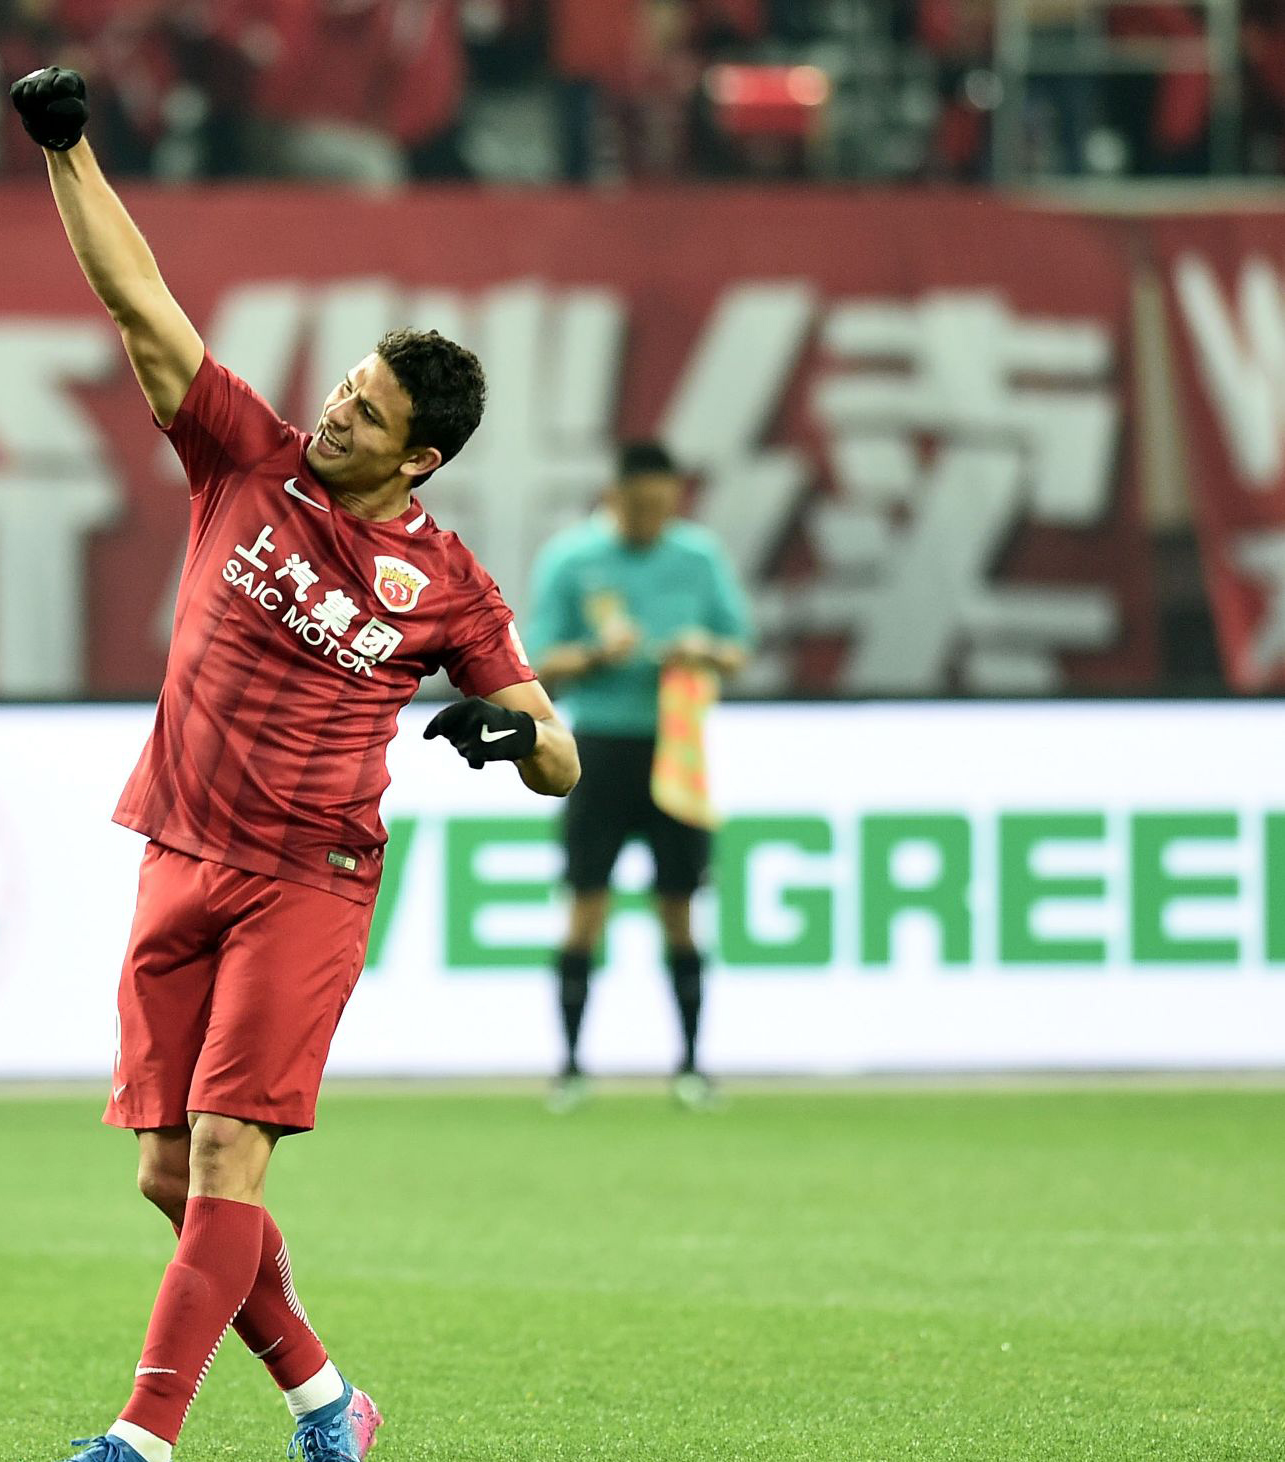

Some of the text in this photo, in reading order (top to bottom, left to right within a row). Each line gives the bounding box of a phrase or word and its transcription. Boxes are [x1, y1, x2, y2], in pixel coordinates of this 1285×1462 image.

[222, 559, 377, 678] SAIC MOTOR
[234, 524, 404, 663] 上汽集团
